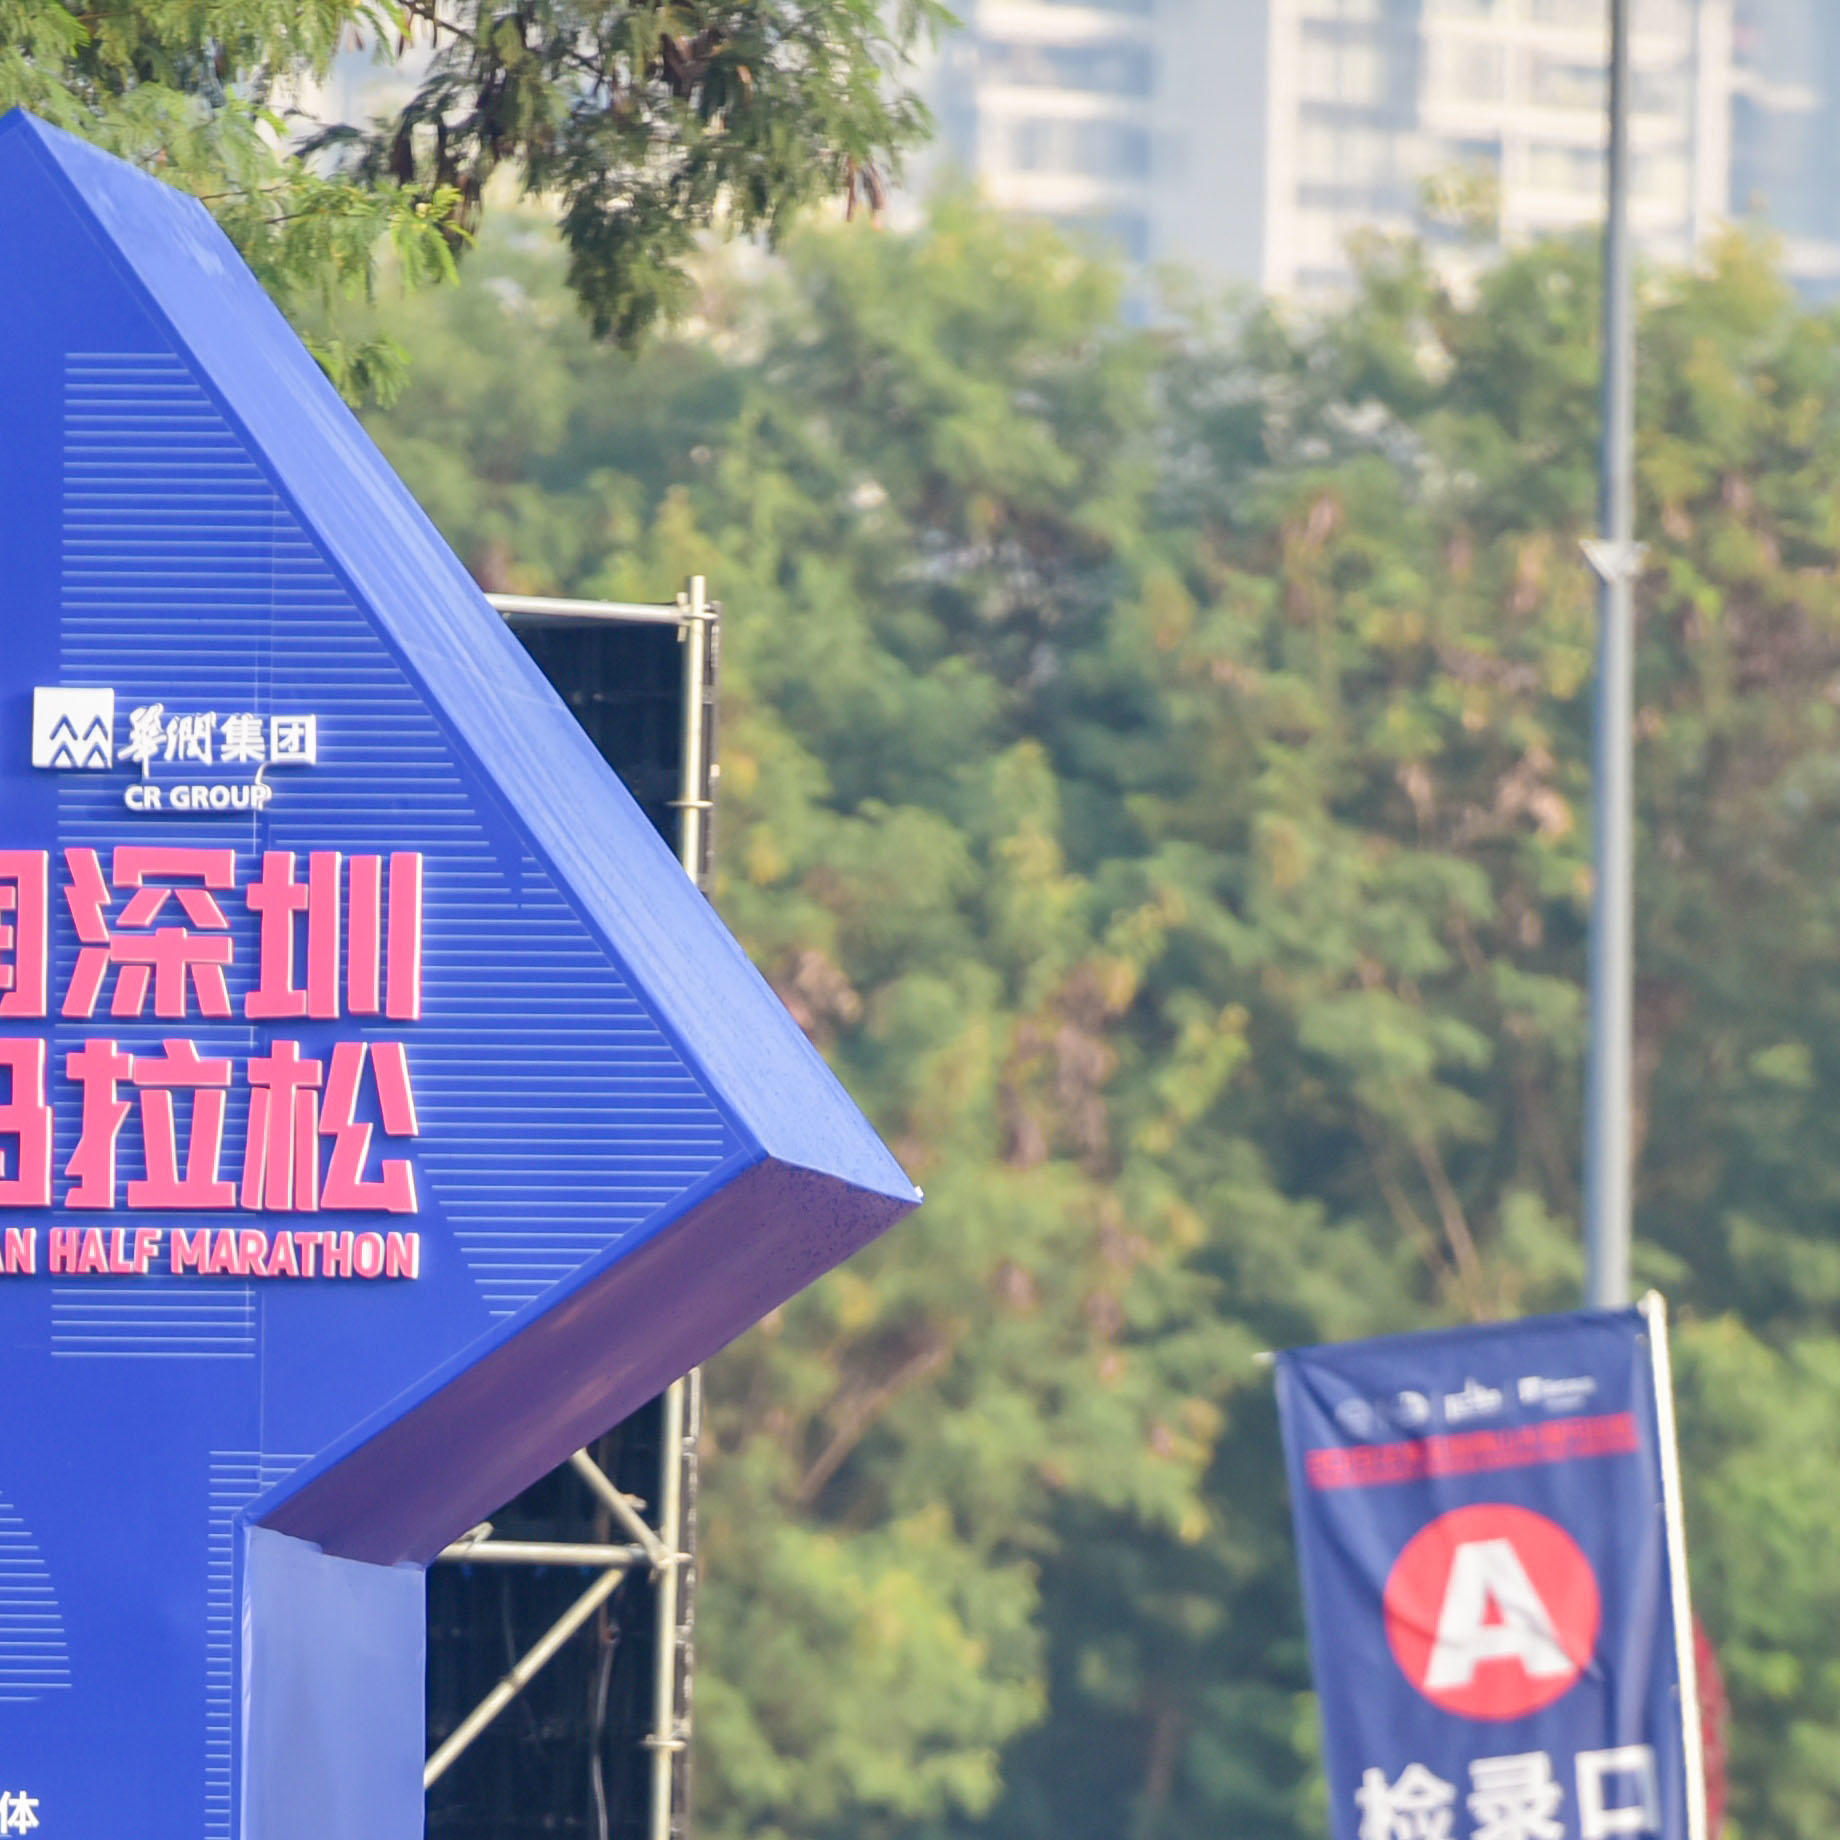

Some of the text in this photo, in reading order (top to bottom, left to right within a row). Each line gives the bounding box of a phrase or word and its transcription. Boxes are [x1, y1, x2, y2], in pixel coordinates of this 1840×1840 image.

[125, 785, 271, 811] CR GROUP
[49, 1227, 159, 1276] HALF
[169, 1228, 420, 1279] MARATHON
[1423, 1538, 1573, 1690] A
